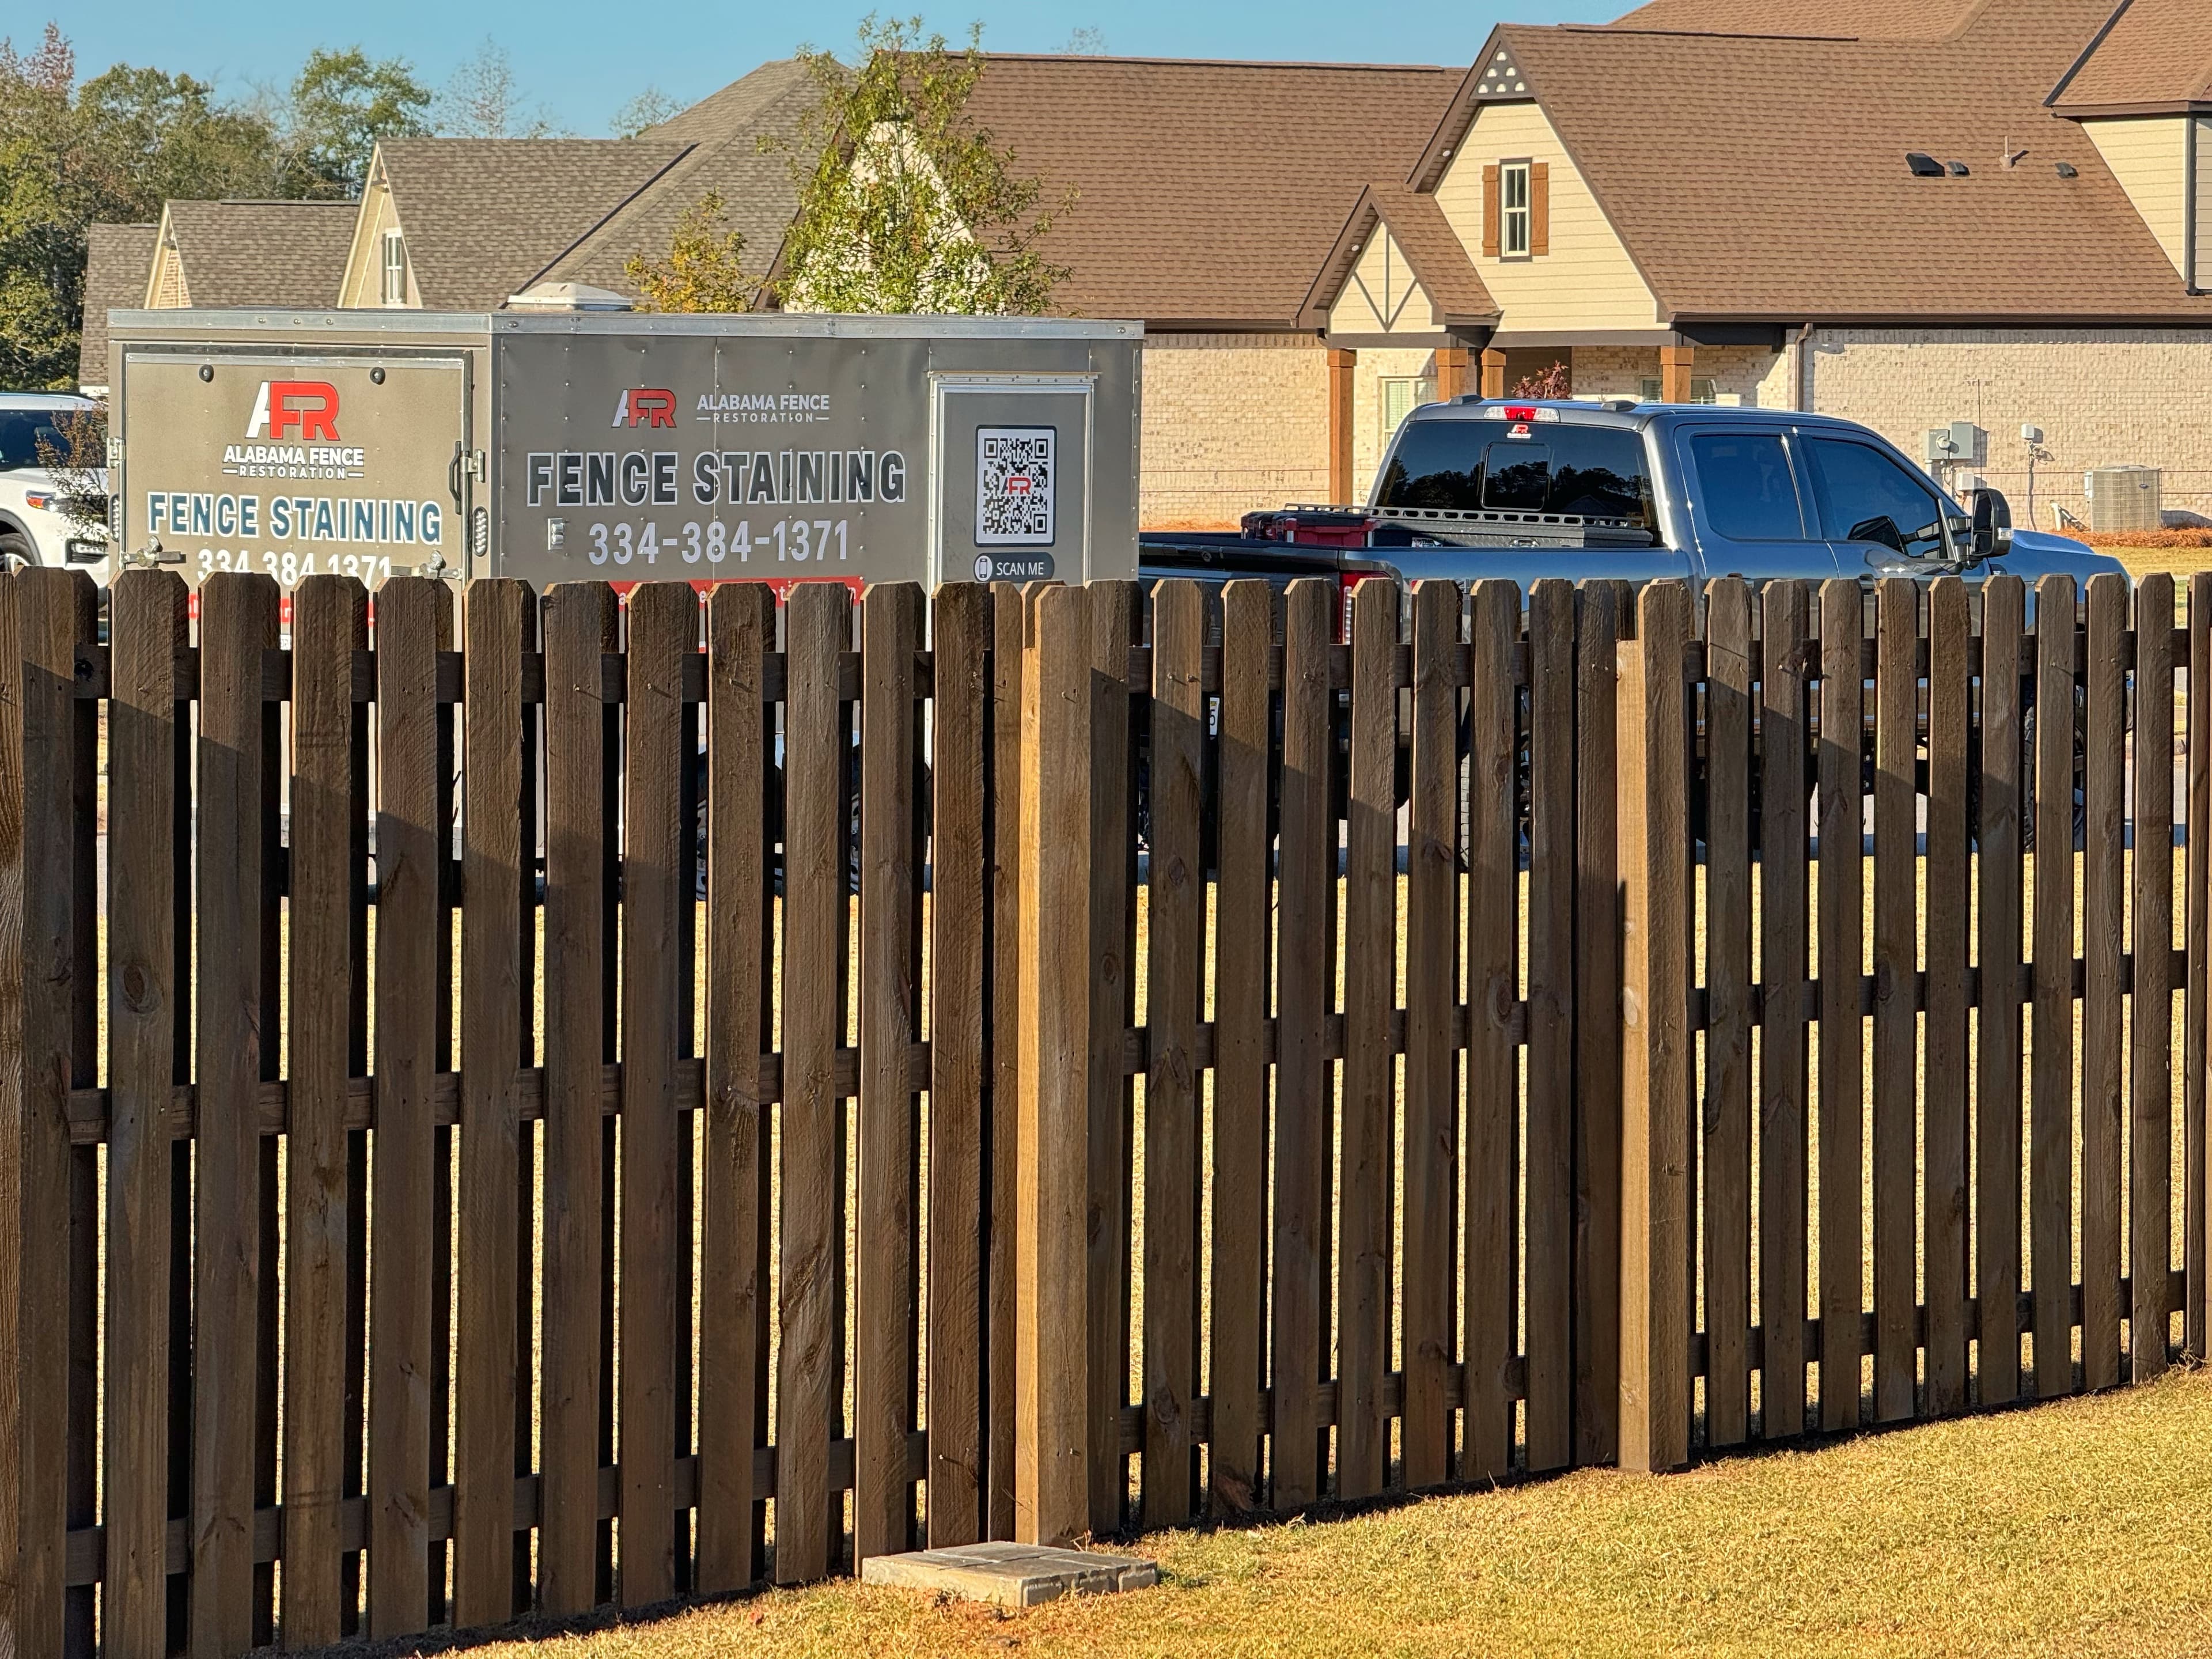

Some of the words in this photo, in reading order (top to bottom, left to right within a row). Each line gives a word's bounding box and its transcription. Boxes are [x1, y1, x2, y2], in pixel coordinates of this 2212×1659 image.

[245, 380, 341, 441] AFR
[611, 388, 677, 428] AFR
[696, 394, 776, 411] ALABAMA
[780, 395, 830, 410] FENCE
[713, 412, 813, 423] RESTORATION
[222, 444, 306, 465] ALABAMA
[309, 446, 365, 466] FENCE
[238, 465, 346, 480] RESTORATION
[527, 452, 678, 507] FENCE
[692, 450, 906, 505] STAINING
[147, 491, 259, 538] FENCE
[270, 495, 442, 545] STAINING
[588, 519, 848, 565] 334-384-1371
[996, 562, 1025, 576] SCAN
[1028, 562, 1044, 575] ME
